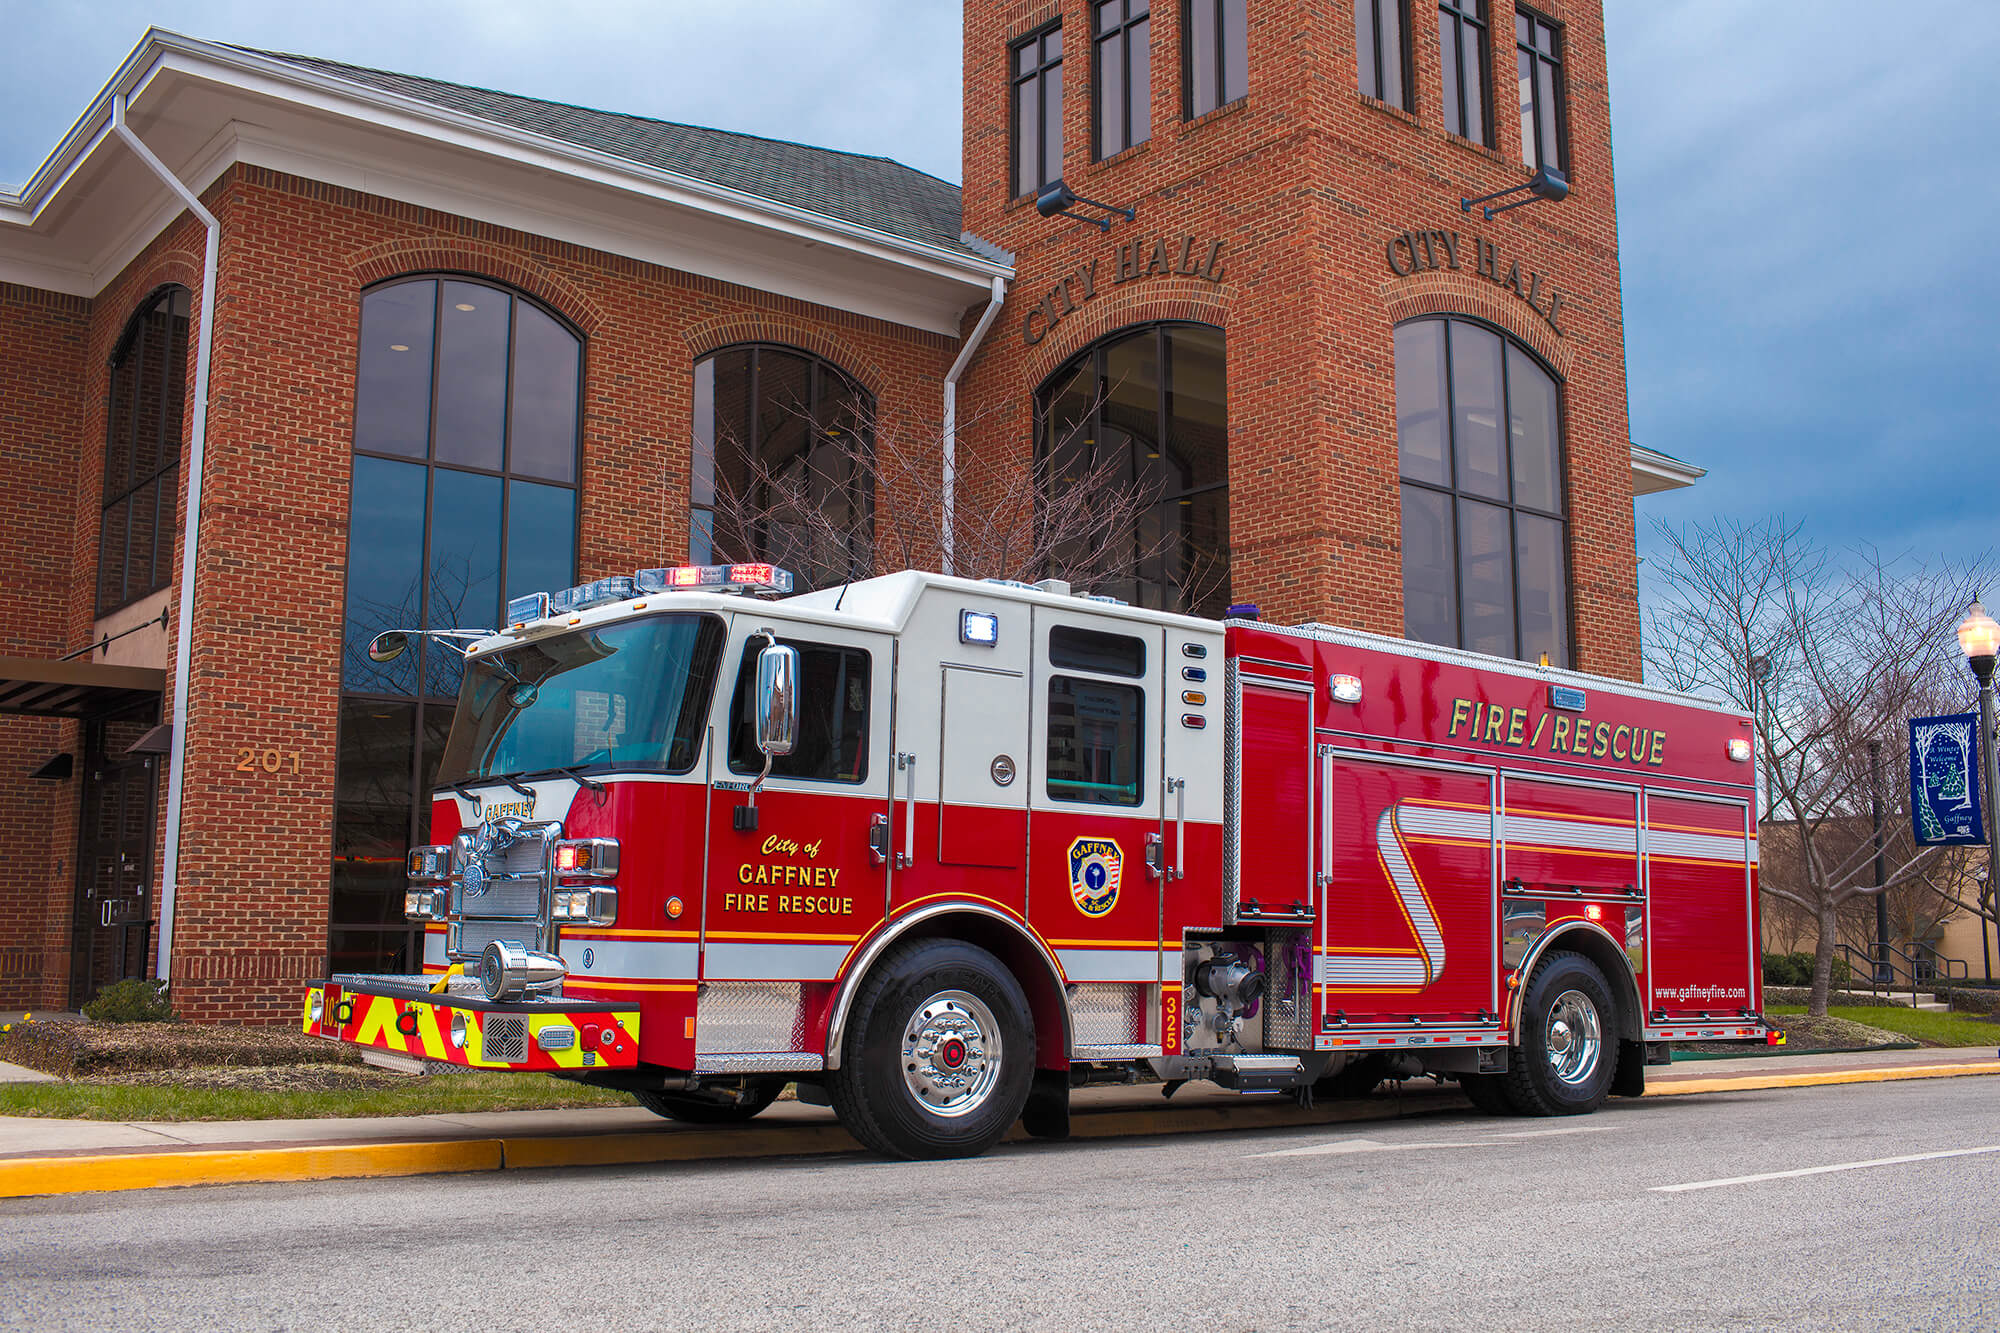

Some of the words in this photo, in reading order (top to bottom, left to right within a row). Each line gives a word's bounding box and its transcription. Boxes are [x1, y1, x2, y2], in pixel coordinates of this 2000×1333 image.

[1023, 258, 1098, 345] CITY
[1113, 236, 1225, 284] HALL
[1387, 230, 1460, 276] CITY
[1476, 238, 1567, 337] HALL
[236, 746, 300, 774] 201
[485, 801, 535, 822] GAFFNEY
[1944, 813, 1973, 825] Gaffney
[760, 834, 799, 858] City
[802, 839, 822, 860] of
[1072, 842, 1120, 860] GAFFNEY
[738, 863, 841, 888] GAFFNEY
[724, 893, 769, 912] FIRE
[778, 895, 853, 915] RESCUE
[1655, 984, 1746, 1003] www.gaffneyfire.com
[1167, 997, 1176, 1049] 325
